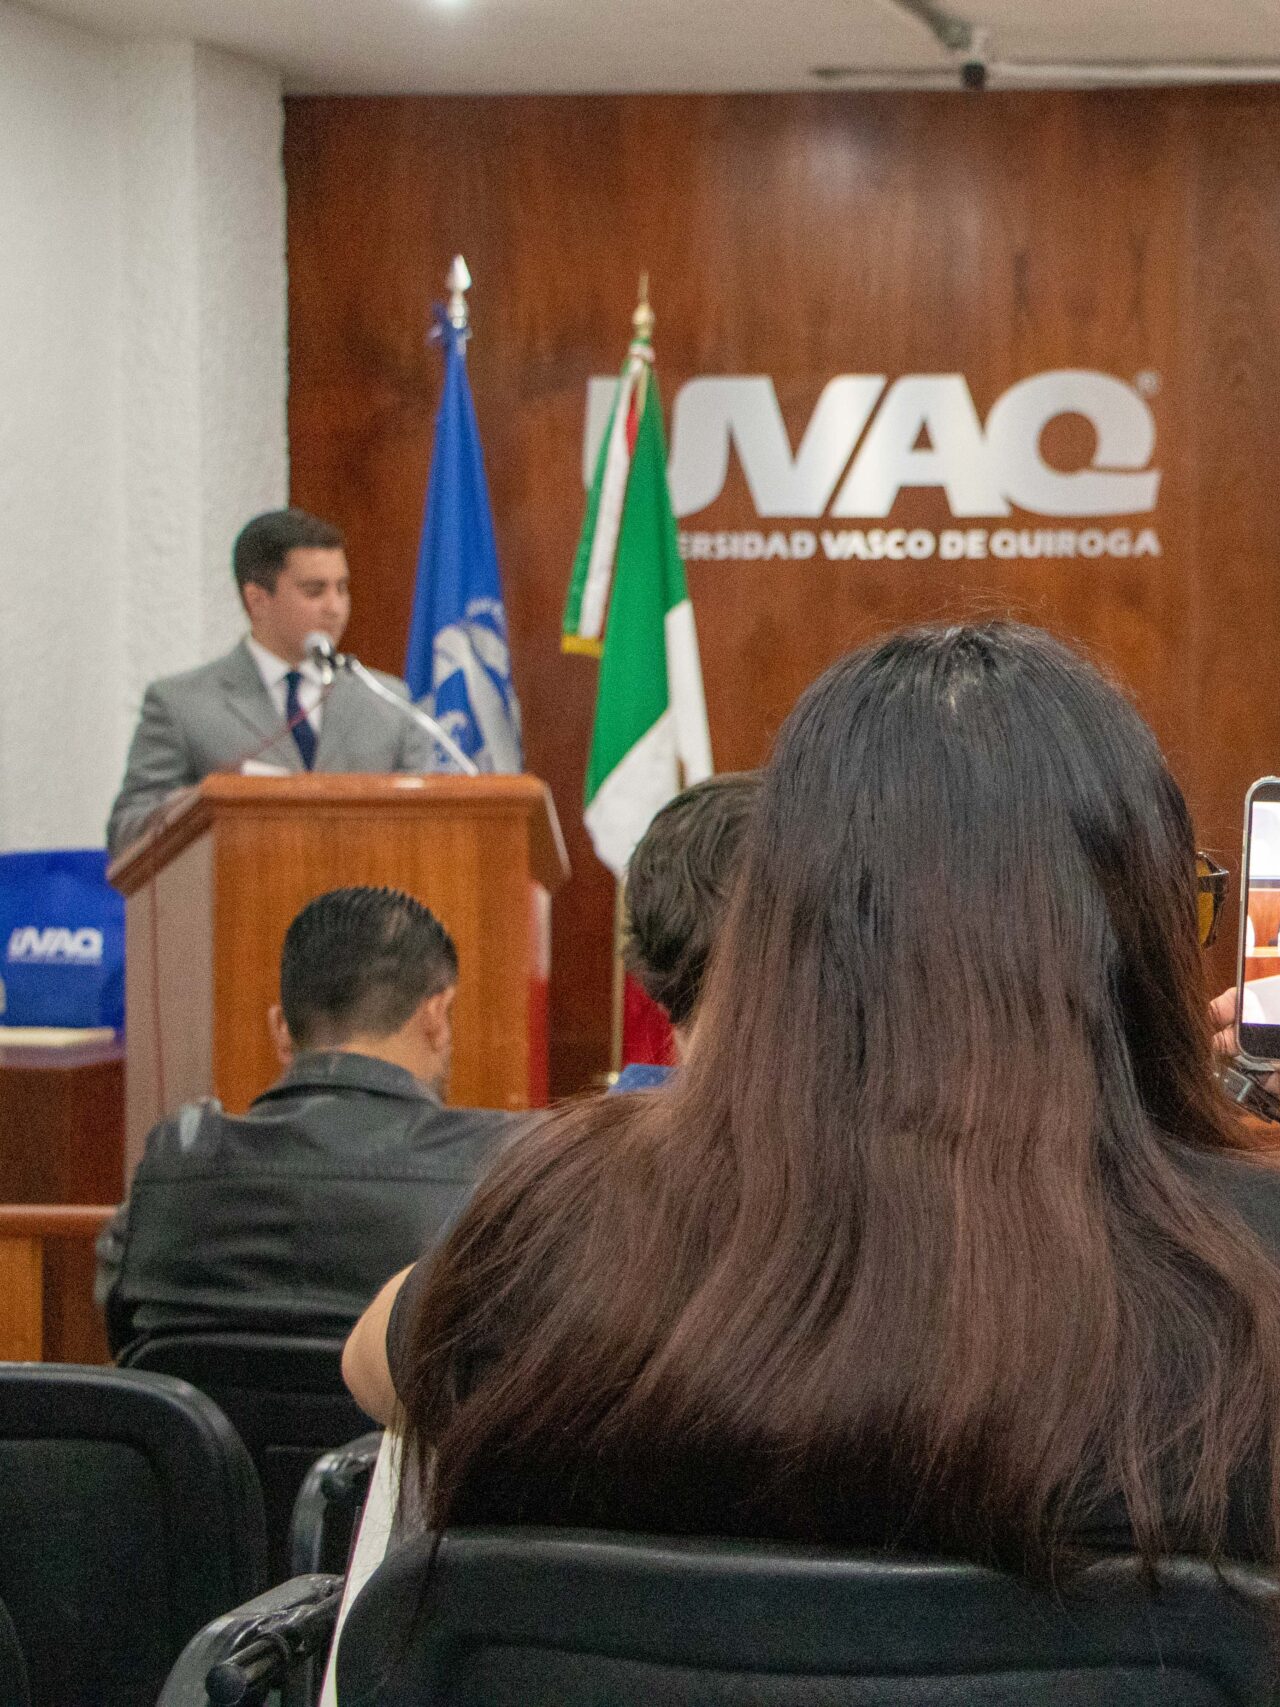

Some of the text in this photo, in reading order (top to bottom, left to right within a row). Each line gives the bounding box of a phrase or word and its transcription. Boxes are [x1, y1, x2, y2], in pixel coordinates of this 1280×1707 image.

[820, 530, 935, 560] VASCO
[939, 530, 988, 559] DE
[990, 528, 1161, 558] QUIROGA
